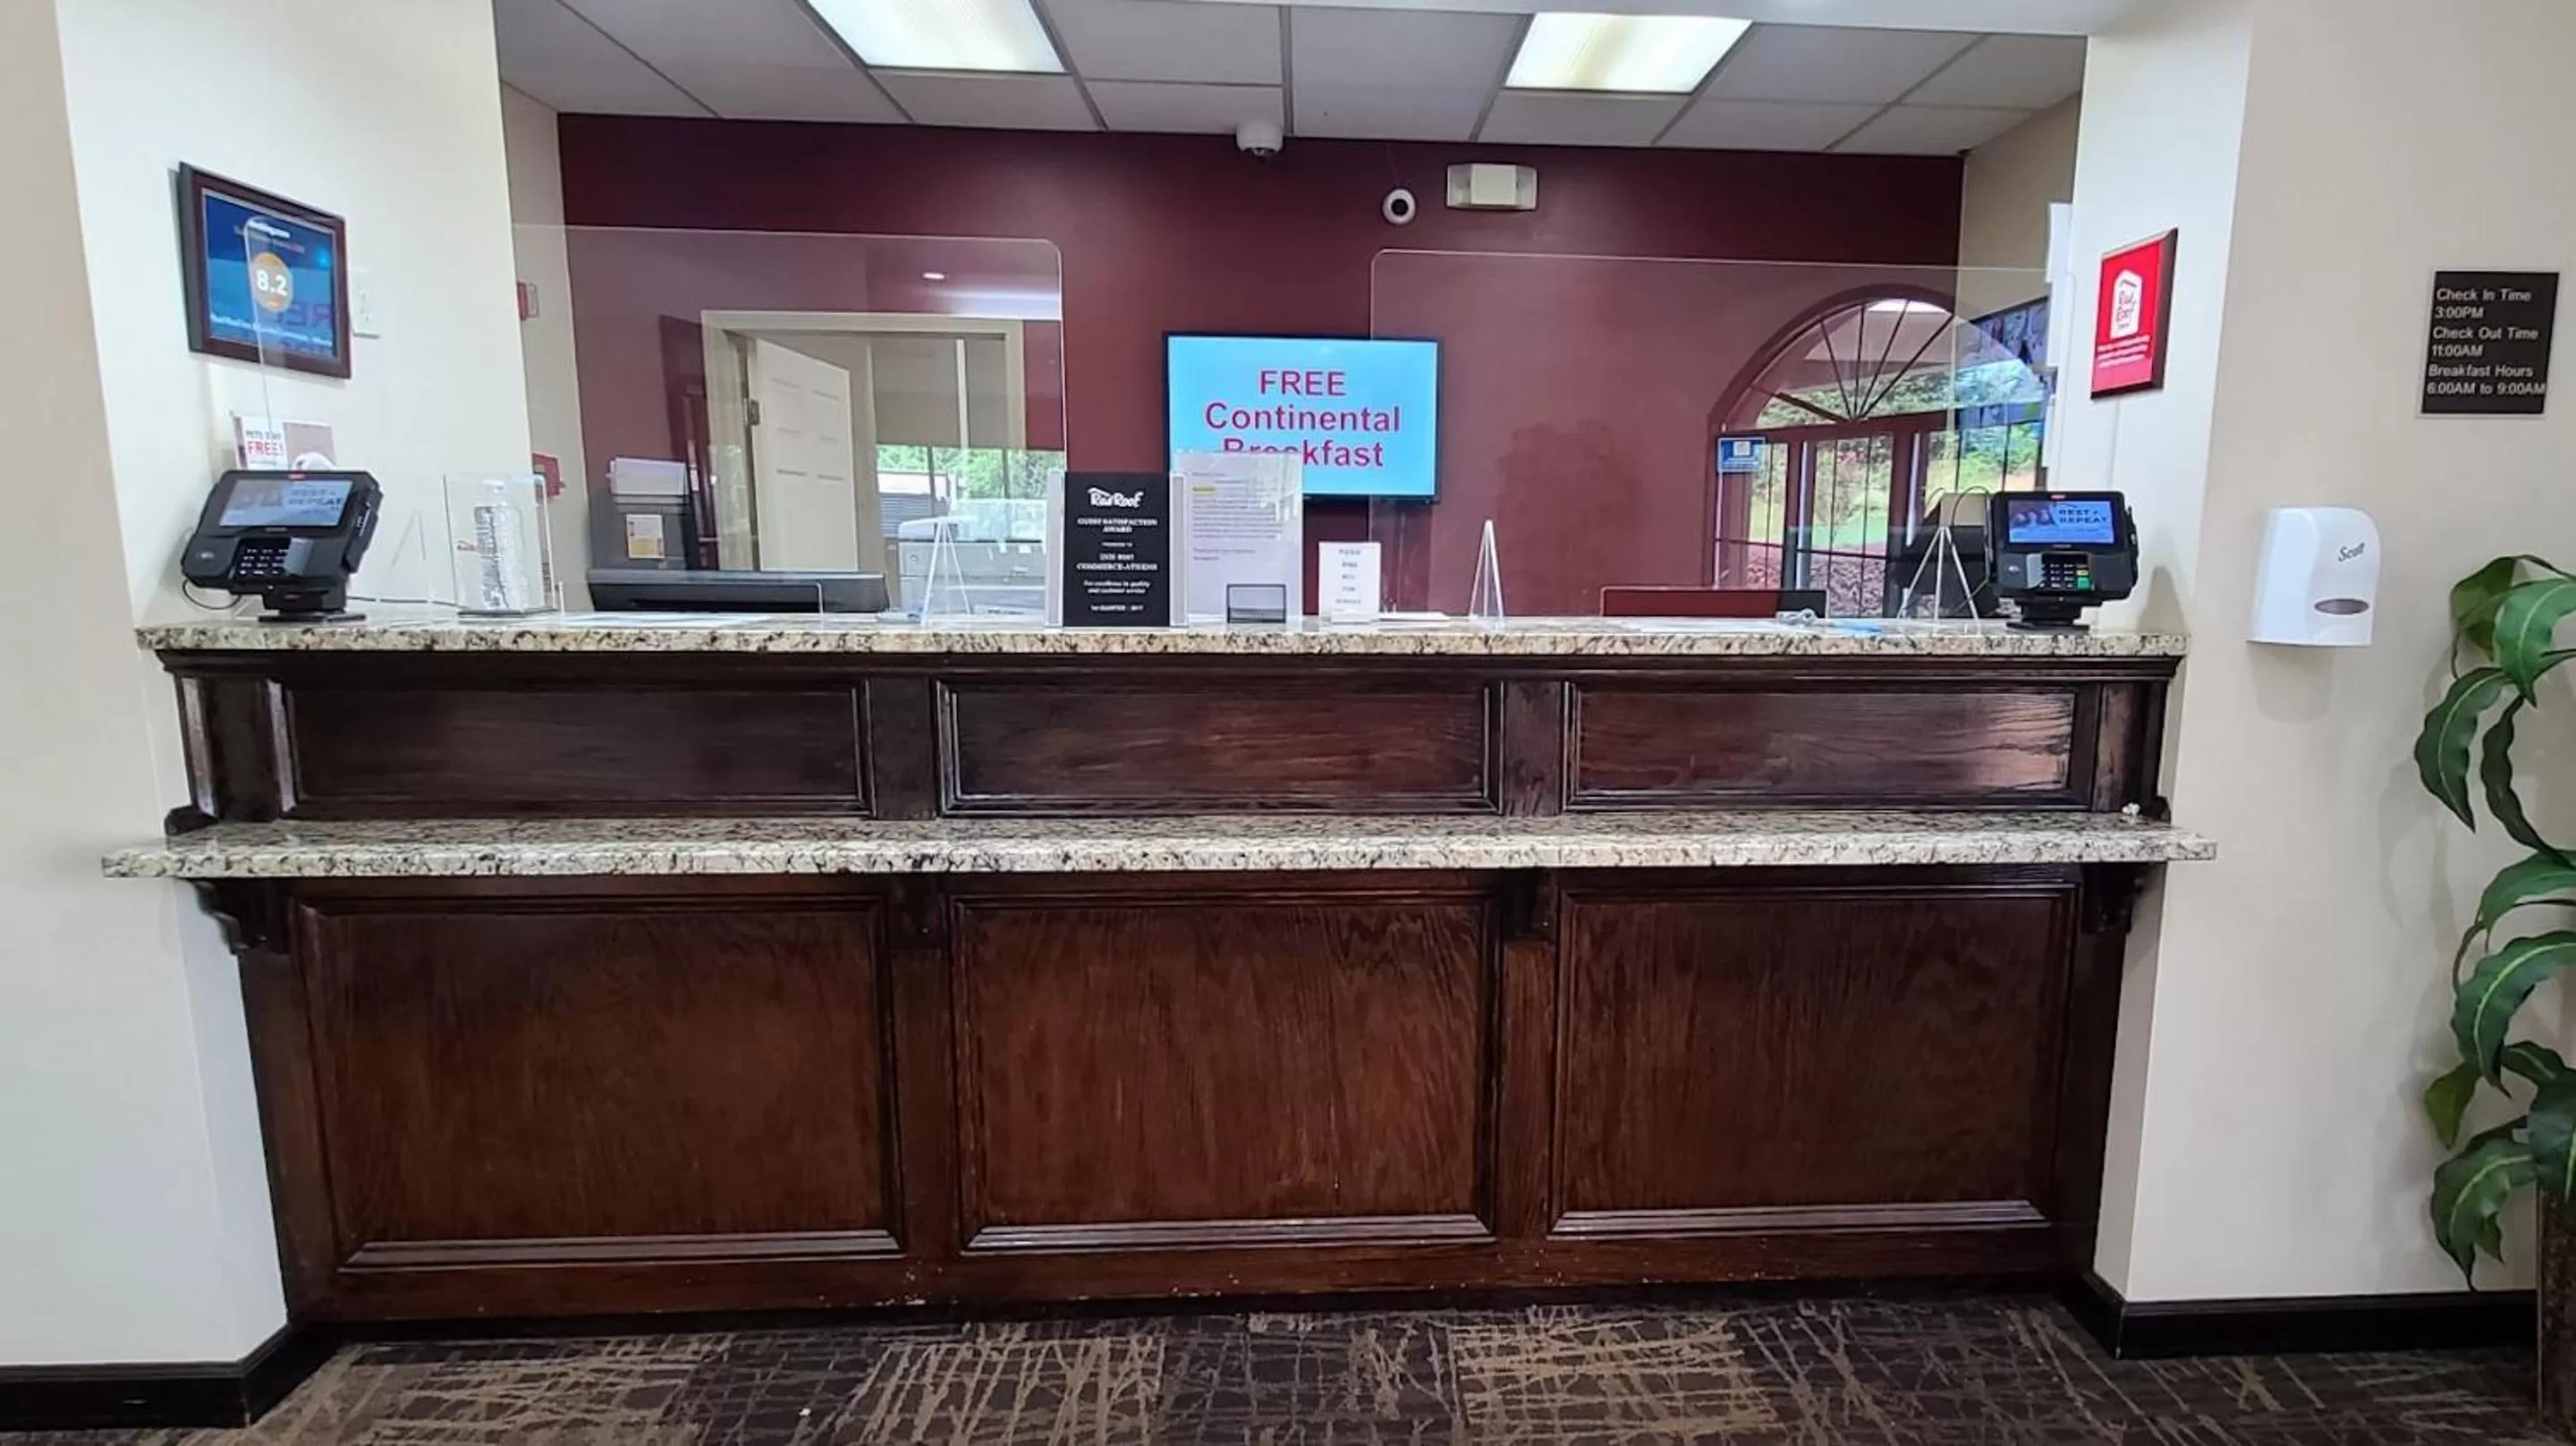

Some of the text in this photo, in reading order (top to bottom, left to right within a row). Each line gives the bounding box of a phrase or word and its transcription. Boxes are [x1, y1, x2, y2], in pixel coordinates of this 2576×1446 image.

[256, 269, 288, 296] 8.2
[2436, 288, 2532, 300] Check In Time
[2435, 307, 2484, 318] 3:00PM
[2433, 326, 2539, 340] Check Out Time
[2431, 344, 2484, 357] 11:00AM
[2428, 364, 2534, 377] Breakfast Hours
[1259, 370, 1346, 395] FREE
[2427, 383, 2546, 394] 6:00AM to 9:00AM
[1206, 402, 1401, 432] Continental
